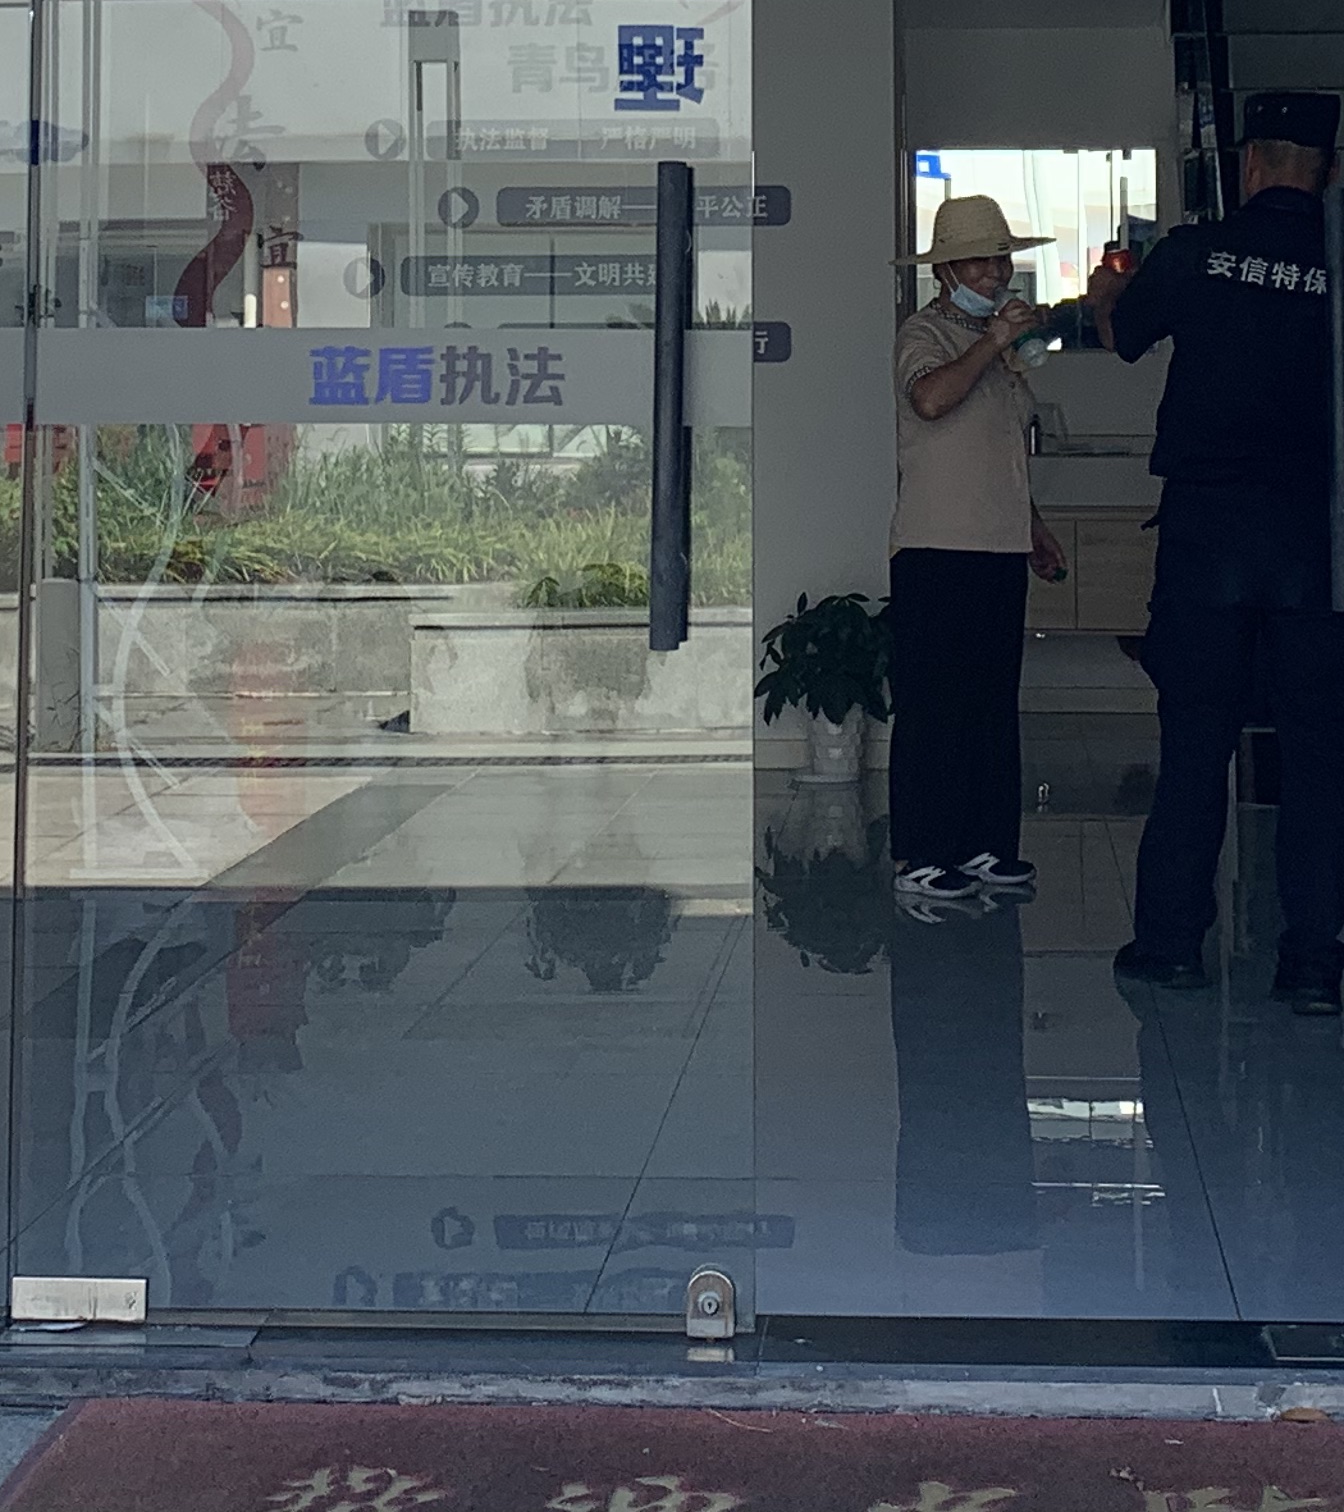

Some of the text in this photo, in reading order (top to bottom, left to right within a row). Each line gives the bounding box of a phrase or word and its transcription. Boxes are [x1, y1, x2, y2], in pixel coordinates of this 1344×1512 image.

[524, 195, 769, 220] 矛盾调解——平公正
[1207, 251, 1327, 295] 安信特保
[308, 345, 567, 407] 蓝盾执法
